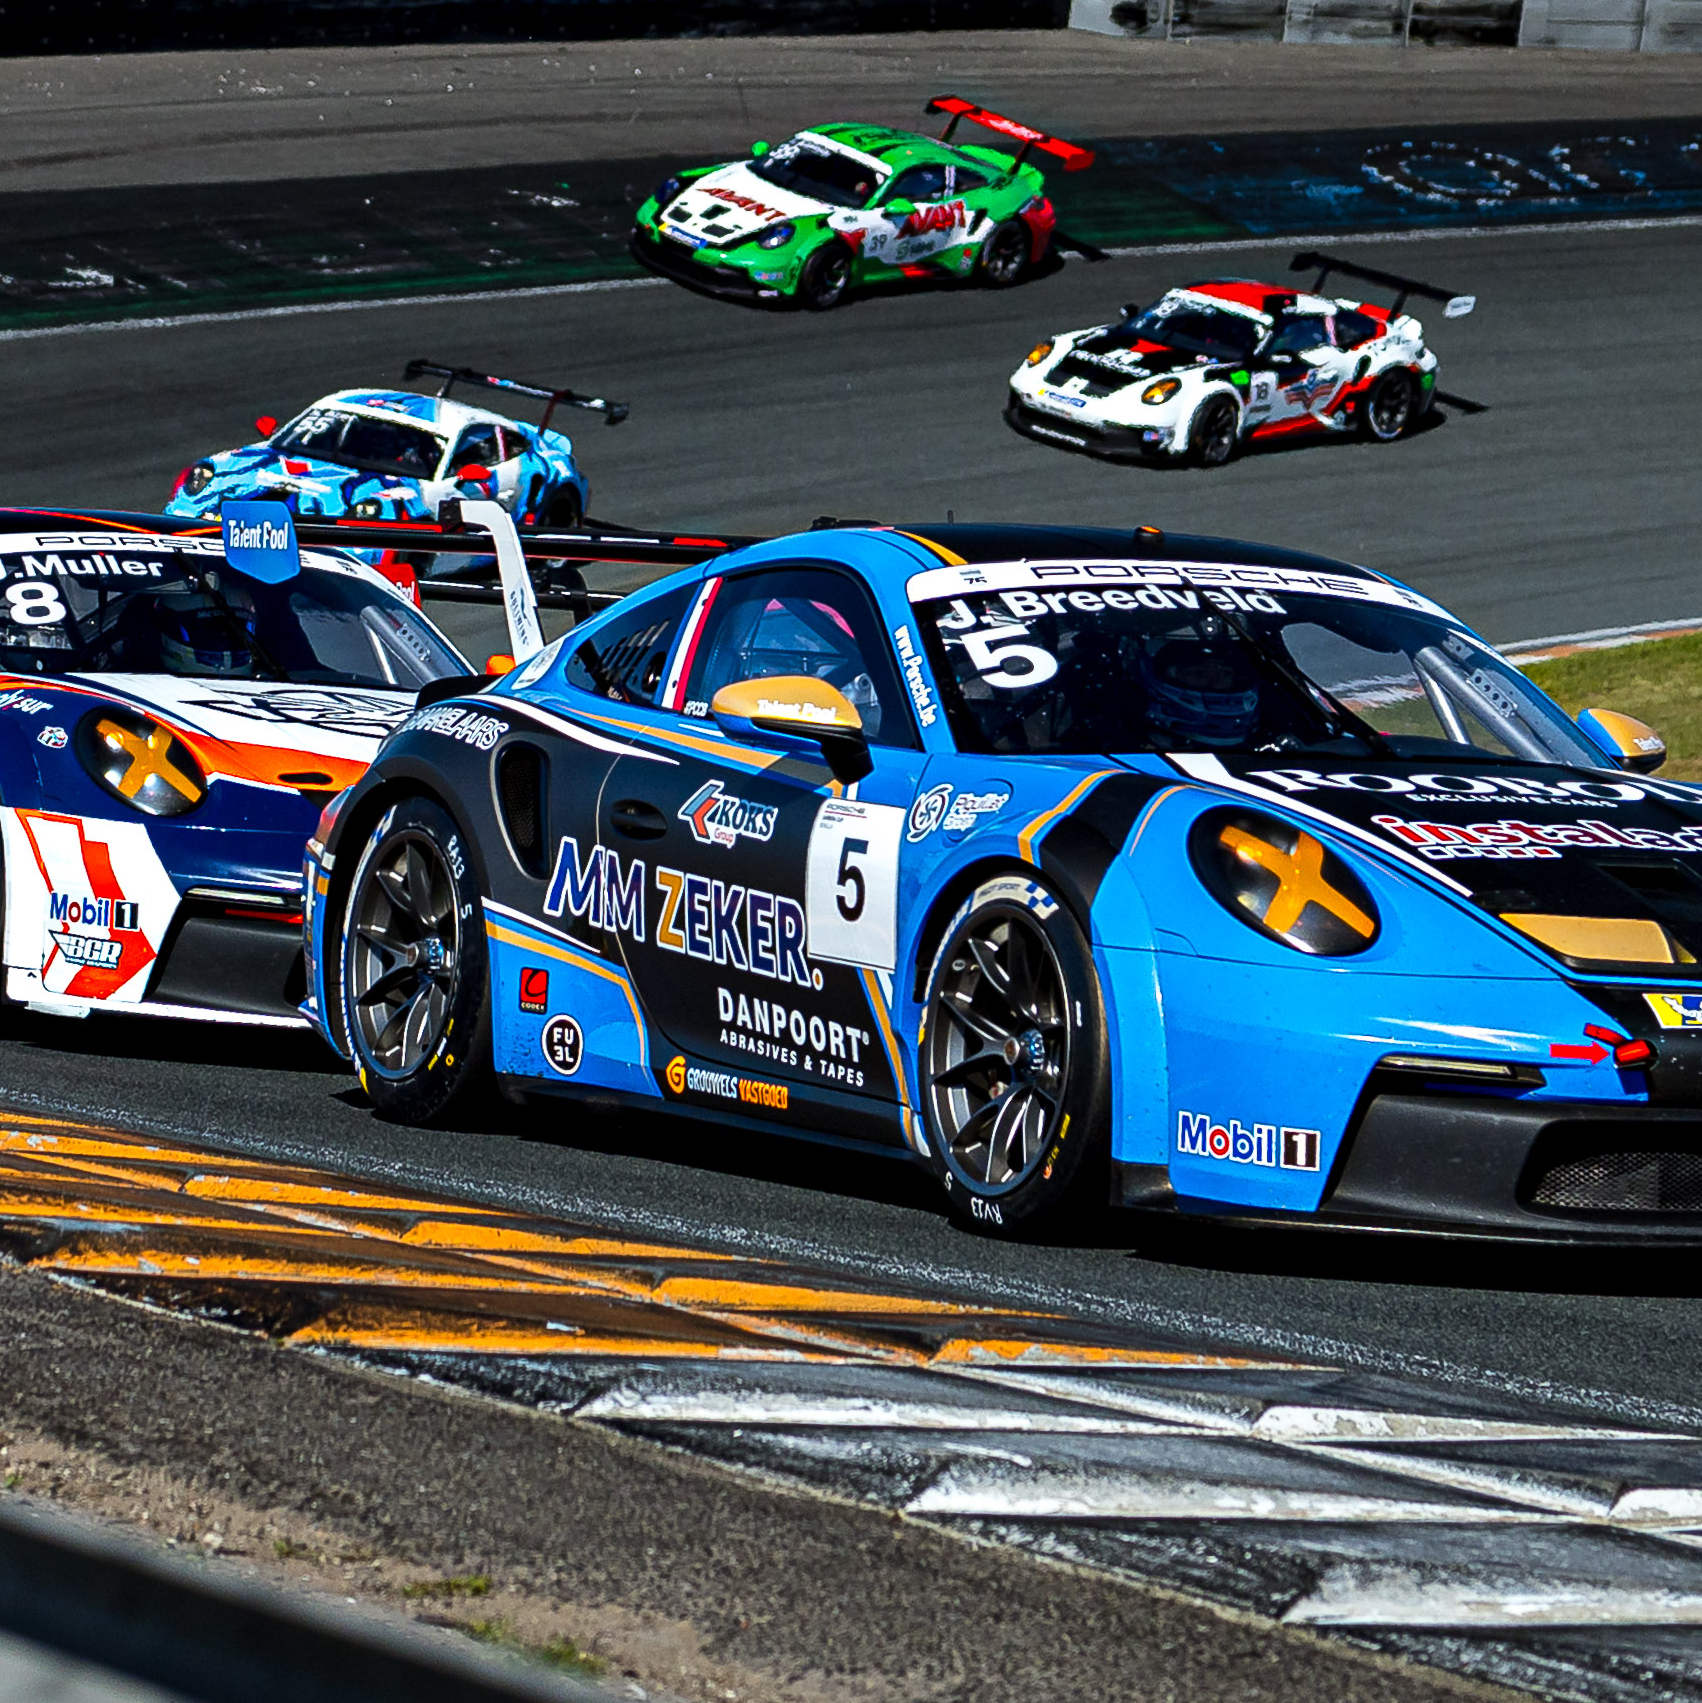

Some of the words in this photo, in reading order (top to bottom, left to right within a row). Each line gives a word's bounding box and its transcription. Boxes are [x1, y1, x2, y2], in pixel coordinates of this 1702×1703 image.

[228, 520, 262, 548] Talent
[1029, 565, 1372, 594] PORSCHE
[5, 582, 67, 625] 8
[999, 584, 1287, 617] Breedveld
[960, 624, 1060, 688] 5
[717, 798, 774, 837] KOKS
[544, 835, 646, 942] MM
[835, 837, 871, 923] 5
[50, 893, 109, 927] Mobil
[460, 902, 472, 920] 5
[521, 1001, 545, 1011] CODEX
[720, 1028, 797, 1066] ABRASIVES
[804, 1055, 813, 1071] &
[820, 1060, 865, 1087] TAPES
[687, 1067, 737, 1099] GROUWELS
[738, 1078, 788, 1109] VASTGOED
[1179, 1112, 1275, 1166] Mobil
